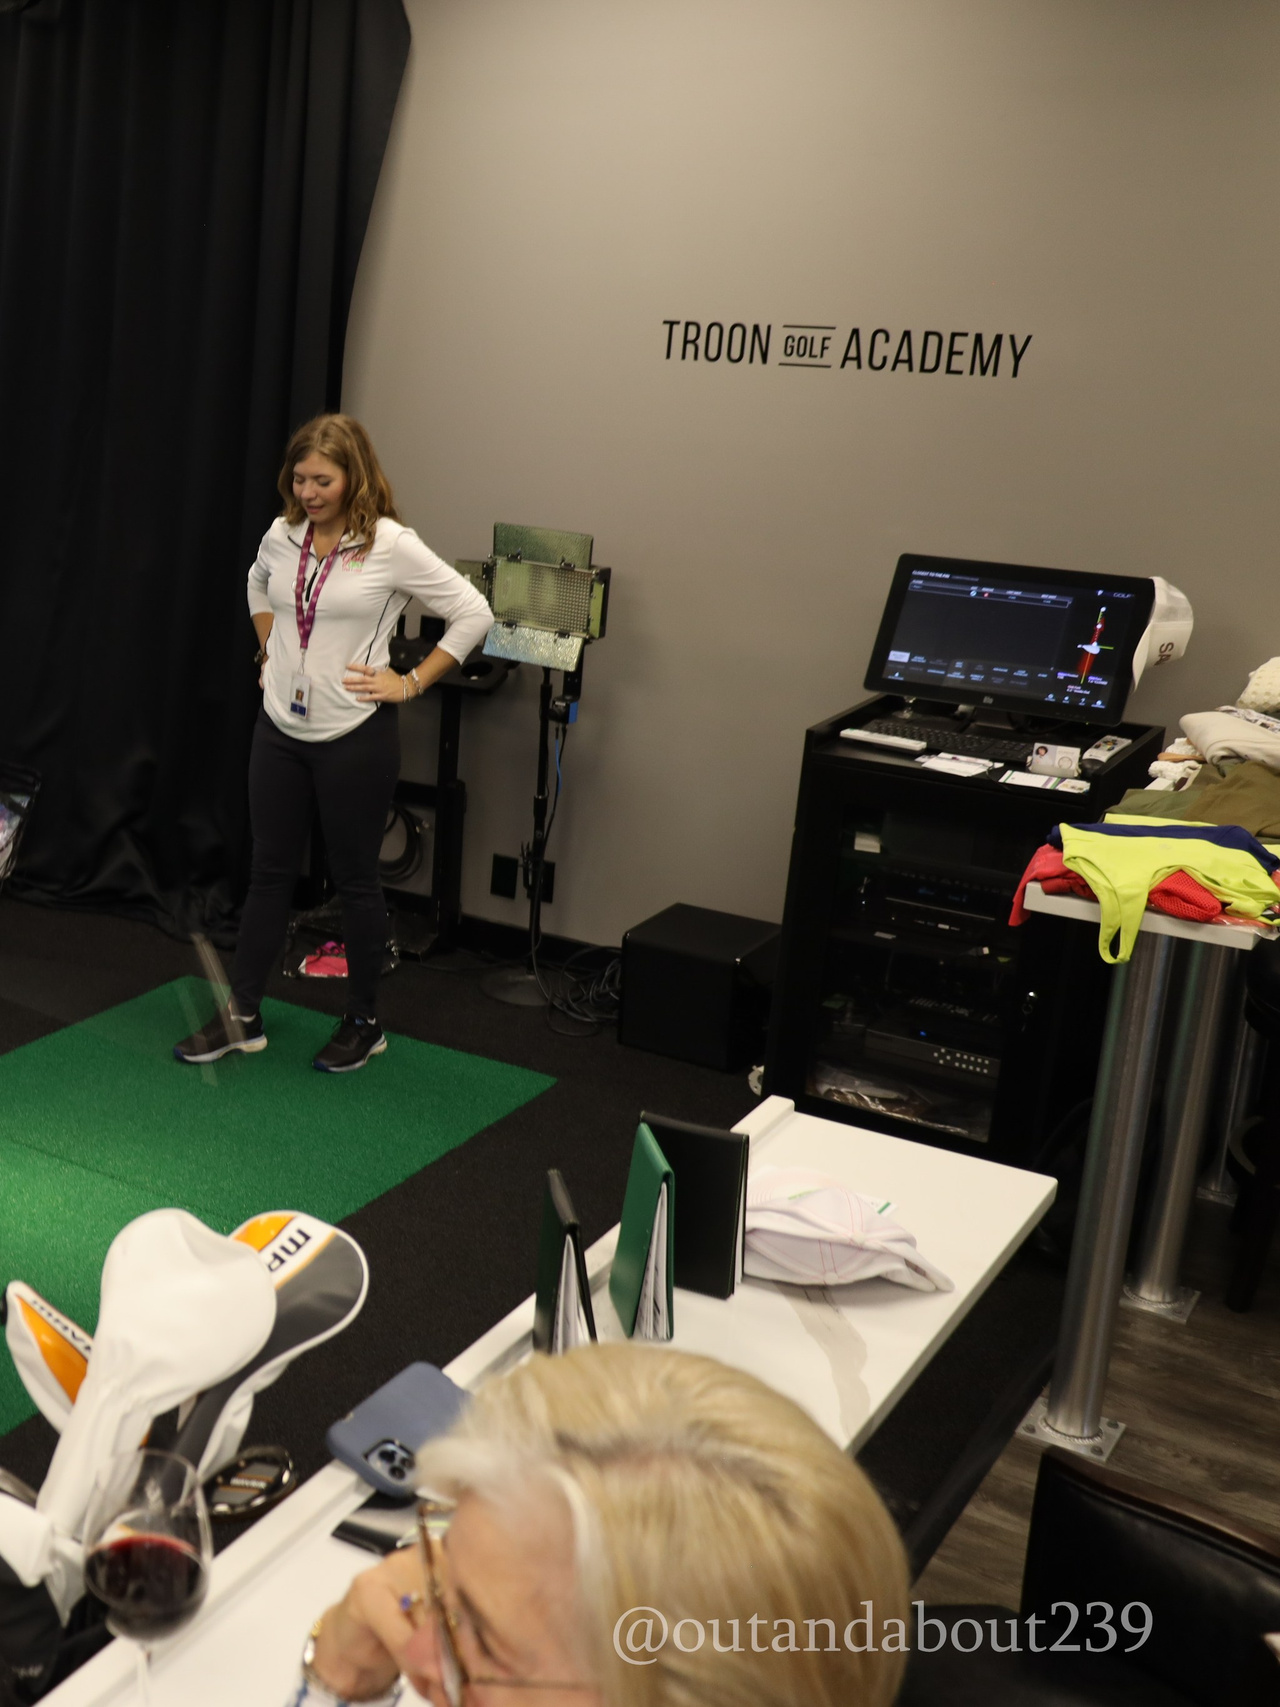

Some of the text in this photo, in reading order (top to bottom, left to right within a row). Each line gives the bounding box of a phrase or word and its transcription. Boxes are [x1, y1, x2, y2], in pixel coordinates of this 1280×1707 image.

[662, 320, 1033, 379] TROON GOLF ACADEMY
